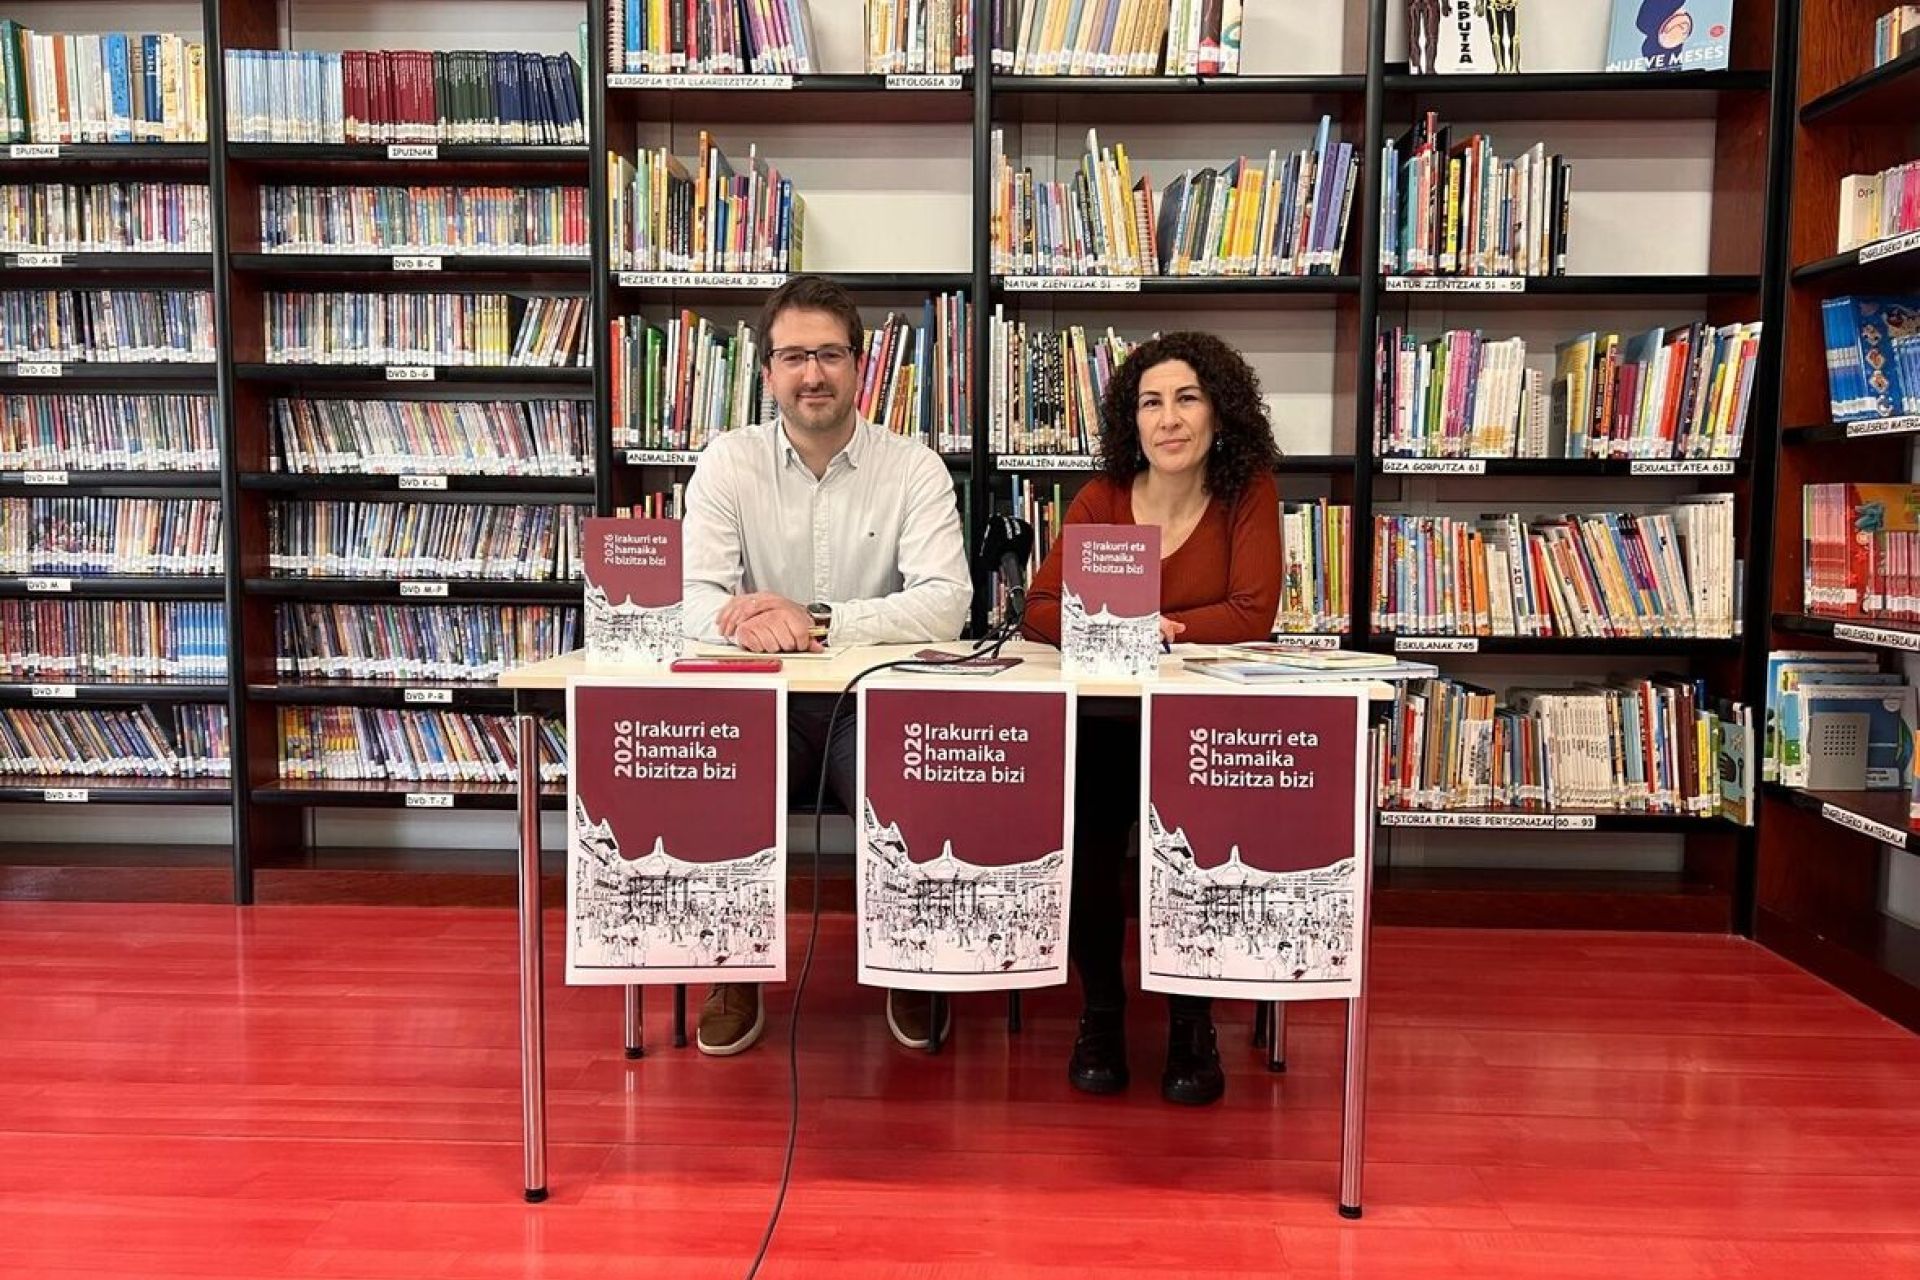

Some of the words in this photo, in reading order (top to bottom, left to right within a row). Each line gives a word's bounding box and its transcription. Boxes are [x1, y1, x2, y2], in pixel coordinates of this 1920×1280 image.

[1608, 54, 1665, 71] NUEVE
[1669, 45, 1724, 66] MESES
[887, 77, 945, 87] MITOLOGIA
[949, 77, 961, 87] 39
[15, 147, 55, 156] IPUINAK
[391, 147, 434, 157] IPUINAK
[19, 256, 37, 265] DVD
[394, 259, 414, 268] DVD
[620, 275, 668, 285] HEZIKETA
[671, 276, 691, 285] ETA
[694, 275, 743, 286] BALOREAK
[1004, 279, 1038, 289] NATUR
[1042, 279, 1097, 289] ZIENTZIAK
[1387, 279, 1421, 289] NATUR
[1424, 279, 1482, 289] ZIENTZIAK
[19, 365, 37, 374] DVD
[388, 369, 405, 378] DVD
[629, 453, 685, 462] ANIMALIEN
[998, 458, 1054, 468] ANIMALIEN
[1384, 462, 1409, 472] GIZA
[1412, 462, 1465, 472] GORPUTZA
[1468, 462, 1480, 473] 61
[1632, 463, 1708, 473] SEXUALITATEA
[1712, 463, 1731, 473] 613
[25, 474, 43, 482] DVD
[400, 478, 419, 487] DVD
[614, 534, 651, 544] Irakurri
[652, 535, 667, 544] eta
[603, 534, 614, 564] 2026
[614, 544, 657, 554] hamaika
[1093, 540, 1128, 551] Irakurri
[1130, 542, 1146, 552] eta
[614, 555, 647, 565] bizitza
[648, 555, 666, 566] bizi
[1081, 540, 1092, 572] 2026
[1093, 551, 1135, 562] hamaika
[1093, 562, 1125, 573] bizitza
[1126, 563, 1144, 574] bizi
[29, 581, 47, 590] DVD
[401, 585, 420, 594] DVD
[1396, 640, 1453, 650] ESKULANAK
[1457, 641, 1474, 650] 745
[34, 687, 52, 696] DVD
[406, 692, 425, 700] DVD
[635, 721, 705, 738] Irakurri
[710, 723, 740, 738] eta
[925, 723, 993, 741] Irakurri
[998, 726, 1029, 742] eta
[1211, 728, 1282, 746] Irakurri
[1287, 731, 1319, 747] eta
[614, 720, 632, 778] 2026
[635, 742, 717, 758] hamaika
[904, 723, 922, 780] 2026
[925, 743, 1006, 762] hamaika
[1189, 728, 1208, 785] 2026
[1211, 748, 1295, 767] hamaika
[635, 762, 698, 779] bizitza
[703, 762, 737, 779] bizi
[924, 764, 987, 782] bizitza
[992, 765, 1024, 783] bizi
[1210, 768, 1275, 787] bizitza
[1280, 770, 1314, 788] bizi
[46, 791, 64, 800] DVD
[407, 796, 426, 805] DVD
[1383, 815, 1430, 825] HISTORIA
[1436, 815, 1454, 825] ETA
[1457, 815, 1482, 826] BERE
[1485, 816, 1554, 827] PERTSONAIAK
[1557, 818, 1569, 827] 90
[1582, 817, 1594, 828] 93
